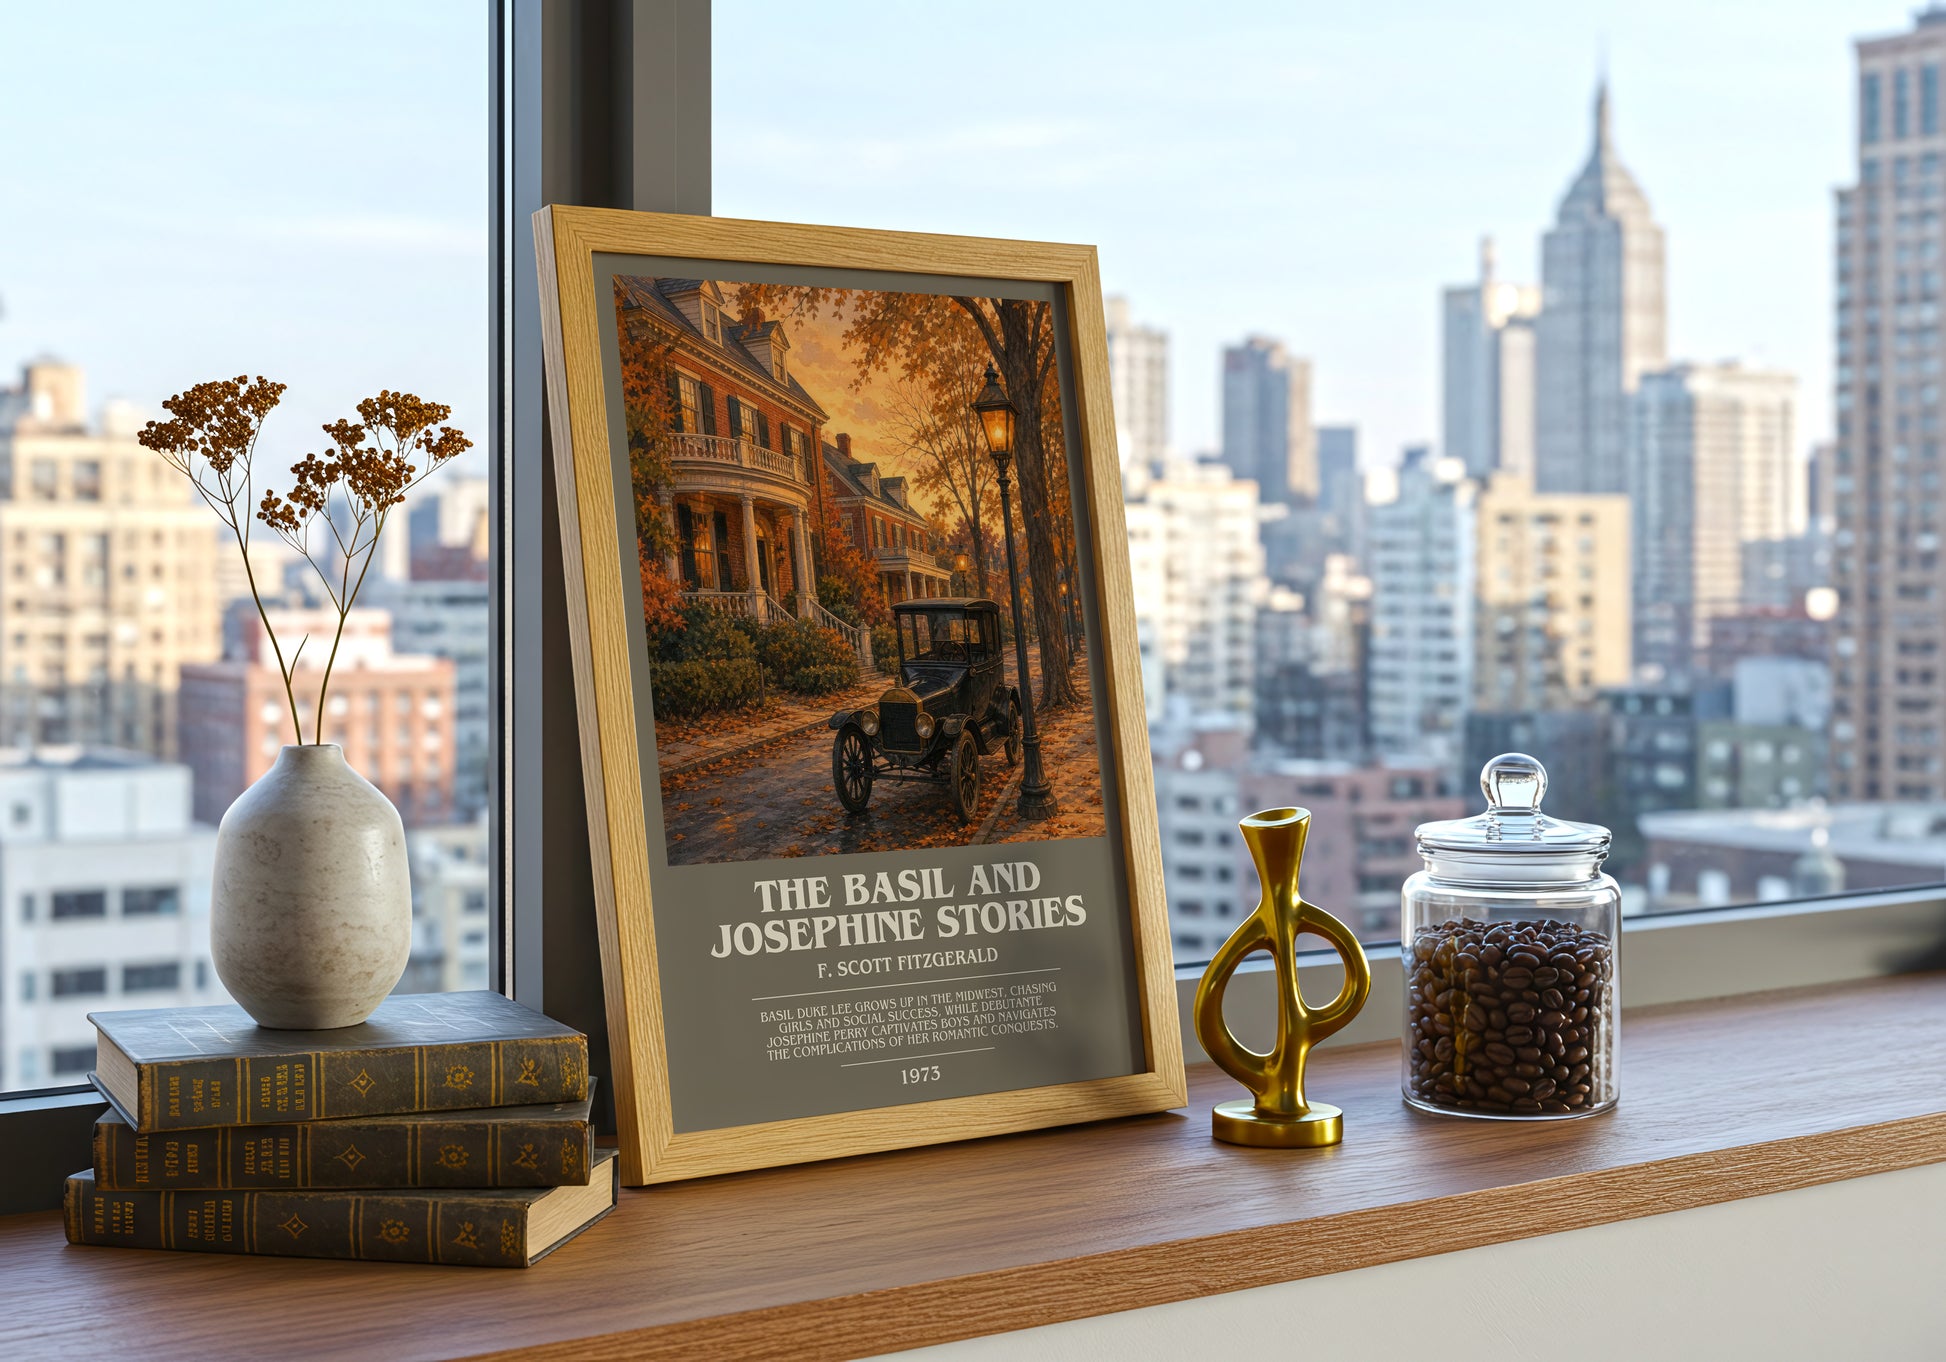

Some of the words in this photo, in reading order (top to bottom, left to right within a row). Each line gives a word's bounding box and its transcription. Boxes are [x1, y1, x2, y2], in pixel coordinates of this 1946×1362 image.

[753, 876, 832, 913] THE
[842, 867, 955, 906] BASIL
[967, 861, 1041, 896] AND
[710, 908, 925, 958] JOSEPHINE
[936, 895, 1088, 939] STORIES
[817, 963, 832, 979] F.
[837, 957, 891, 977] SCOTT
[898, 947, 998, 972] FITZGERALD
[760, 1009, 794, 1023] BASIL
[797, 1005, 828, 1019] DUKE
[831, 1003, 852, 1015] LEE
[855, 998, 897, 1013] GROWS
[900, 996, 914, 1008] UP
[917, 995, 929, 1006] IN
[931, 992, 952, 1005] THE
[955, 987, 1007, 1002] MIDWEST,
[1010, 981, 1057, 996] CHASING
[778, 1020, 813, 1034] GIRLS
[816, 1017, 840, 1030] AND
[843, 1013, 885, 1027] SOCIAL
[888, 1006, 942, 1022] SUCCESS,
[945, 1002, 979, 1016] WHILE
[981, 995, 1043, 1012] DEBUTANTE
[766, 1031, 831, 1048] JOSEPHINE
[834, 1027, 868, 1041] PERRY
[871, 1019, 937, 1036] CAPTIVATES
[941, 1016, 970, 1028] BOYS
[973, 1013, 995, 1025] AND
[998, 1006, 1057, 1022] NAVIGATES
[766, 1049, 790, 1061] THE
[793, 1037, 886, 1058] COMPLICATIONS
[888, 1035, 904, 1048] OF
[907, 1033, 930, 1045] HER
[932, 1026, 989, 1043] ROMANTIC
[991, 1018, 1059, 1035] CONQUESTS.
[900, 1066, 942, 1085] 1973
